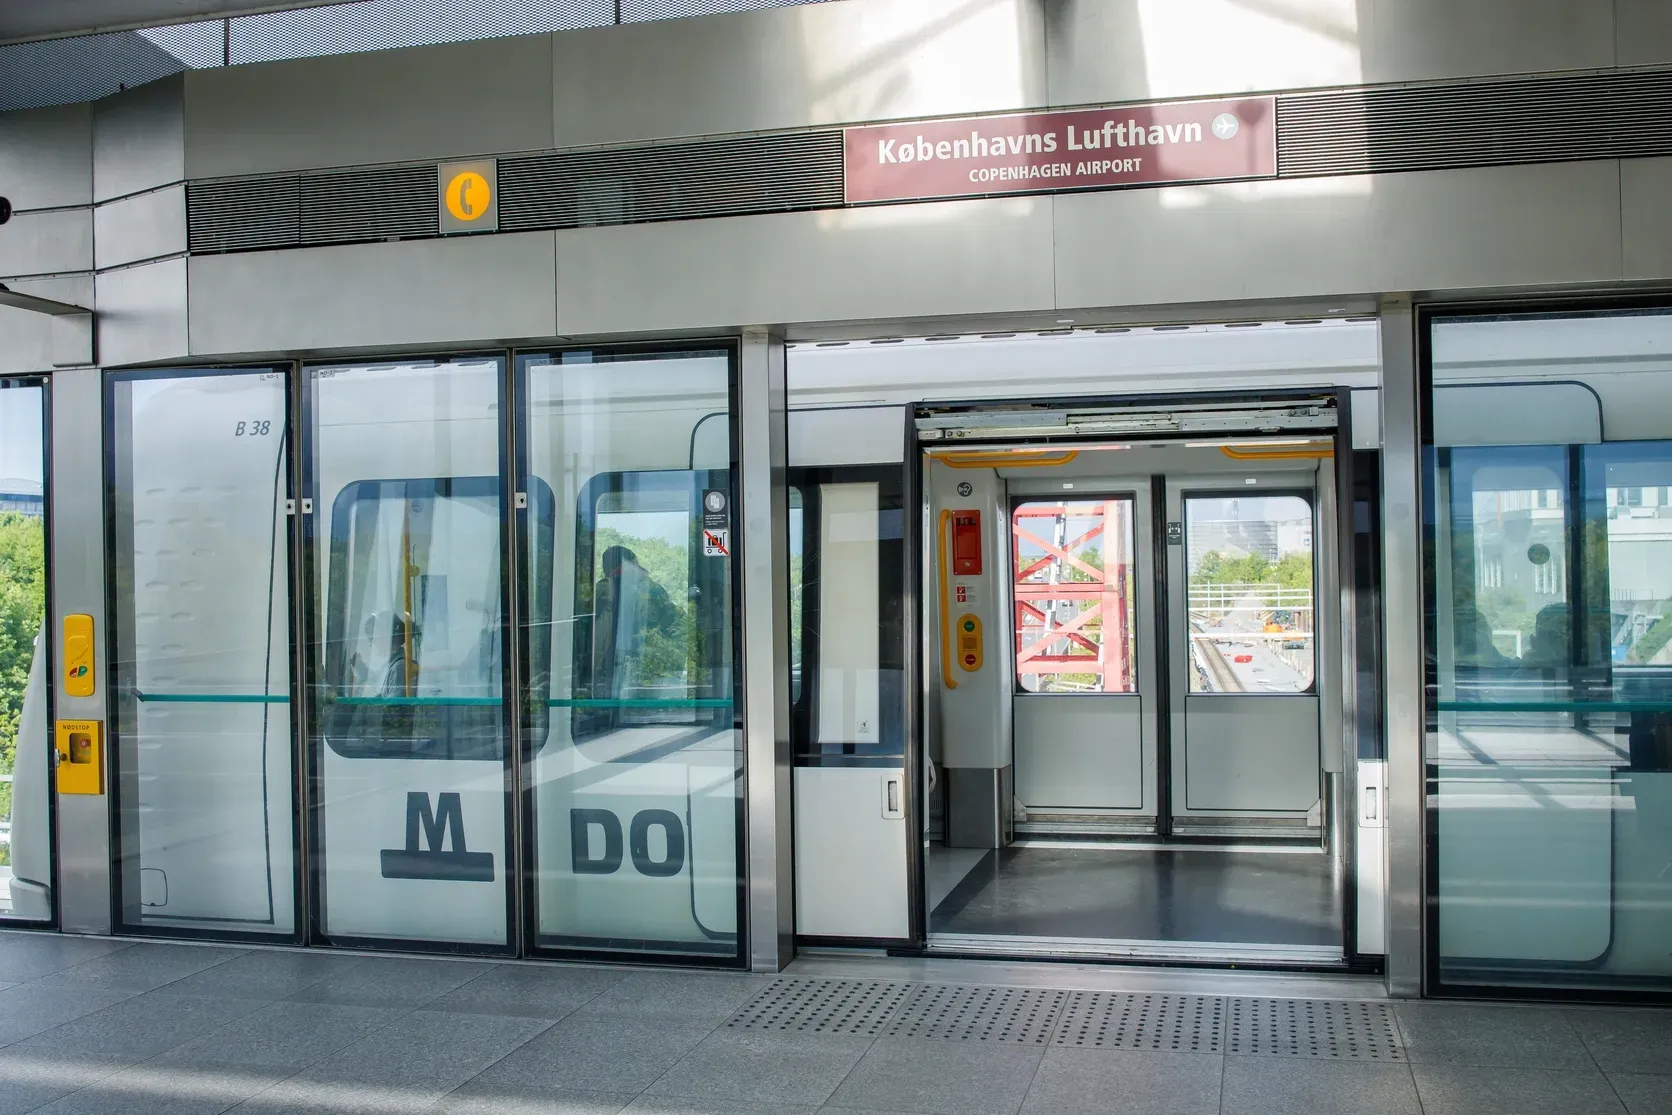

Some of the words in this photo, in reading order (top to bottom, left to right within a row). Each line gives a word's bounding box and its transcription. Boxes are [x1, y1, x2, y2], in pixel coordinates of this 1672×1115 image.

[877, 132, 1057, 164] Københavns
[1067, 119, 1202, 151] Lufthavn
[968, 163, 1072, 183] COPENHAGEN
[1075, 157, 1143, 176] AIRPORT
[234, 421, 247, 437] B
[249, 420, 271, 436] 38
[570, 808, 686, 877] DO
